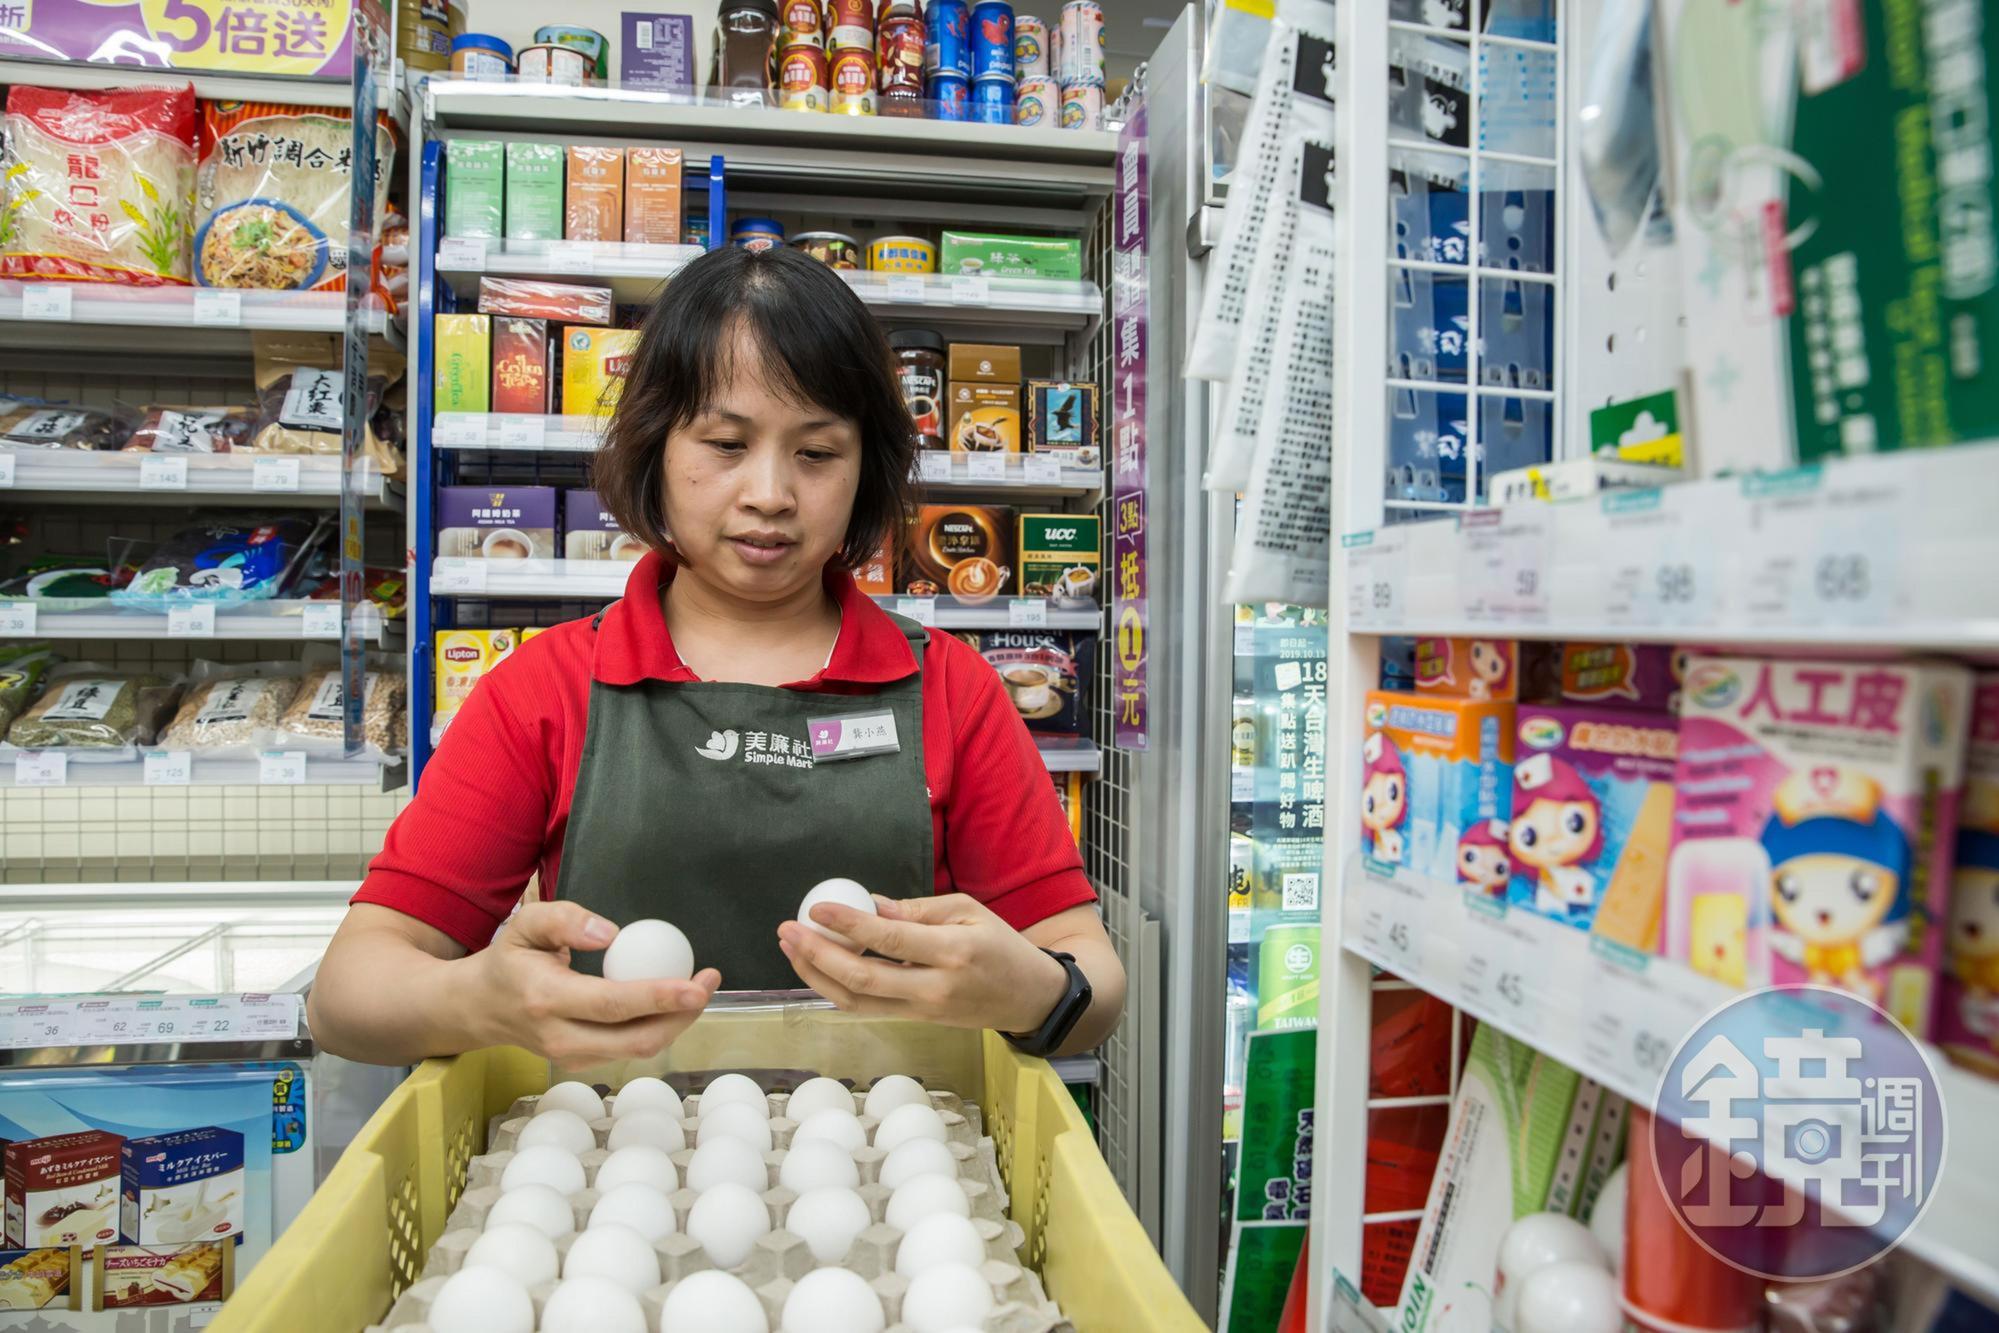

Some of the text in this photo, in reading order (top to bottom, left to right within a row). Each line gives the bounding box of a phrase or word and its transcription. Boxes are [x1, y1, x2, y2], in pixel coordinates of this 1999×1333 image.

[992, 632, 1055, 648] House
[446, 648, 478, 661] Lipton
[1738, 663, 1908, 735] 人工皮
[745, 731, 812, 759] 美廉社
[745, 751, 813, 769] Simple Mart
[45, 1026, 59, 1036] 36
[113, 1022, 127, 1032] 62
[158, 1021, 174, 1034] 69
[214, 1020, 230, 1032] 22
[158, 1151, 228, 1173] ミルクアイスバー
